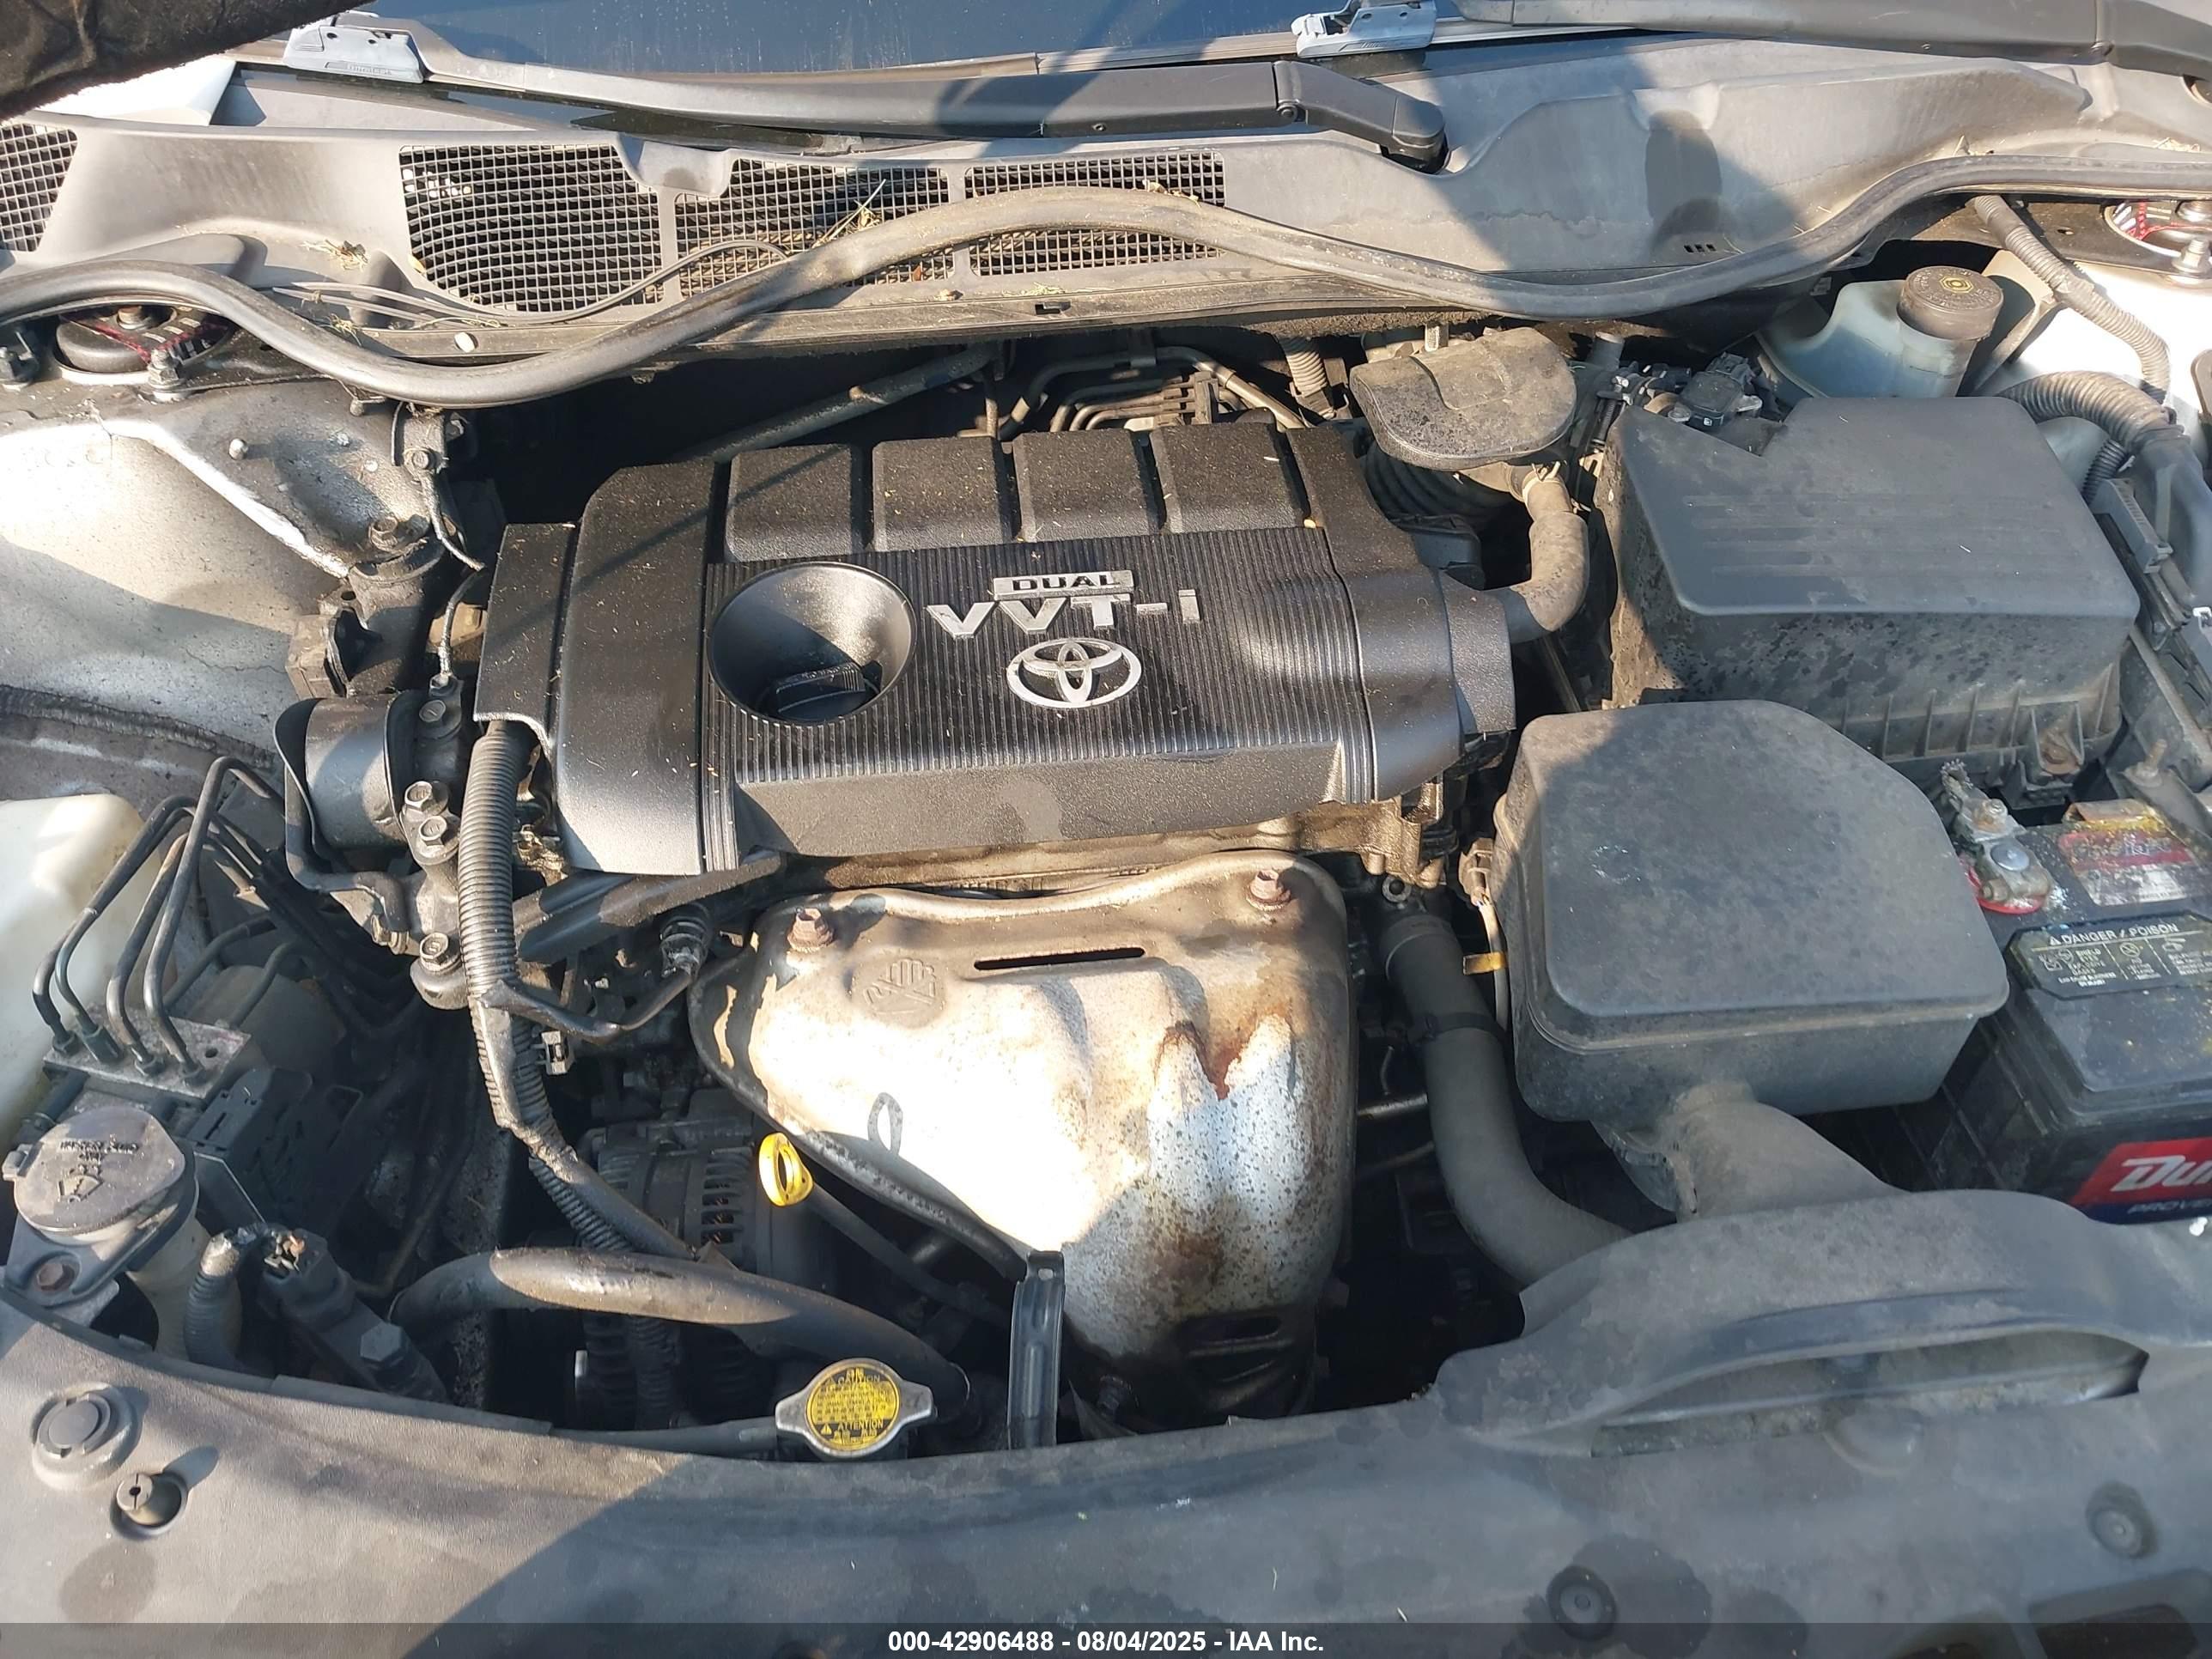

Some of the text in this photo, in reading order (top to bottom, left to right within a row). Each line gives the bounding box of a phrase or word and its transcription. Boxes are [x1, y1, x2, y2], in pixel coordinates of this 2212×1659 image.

[1012, 574, 1121, 591] DUAL
[2061, 923, 2179, 945] DANGER / POISON
[2109, 1154, 2212, 1192] Du
[837, 1375, 880, 1386] CAUTION
[837, 1418, 884, 1430] ATTENTION
